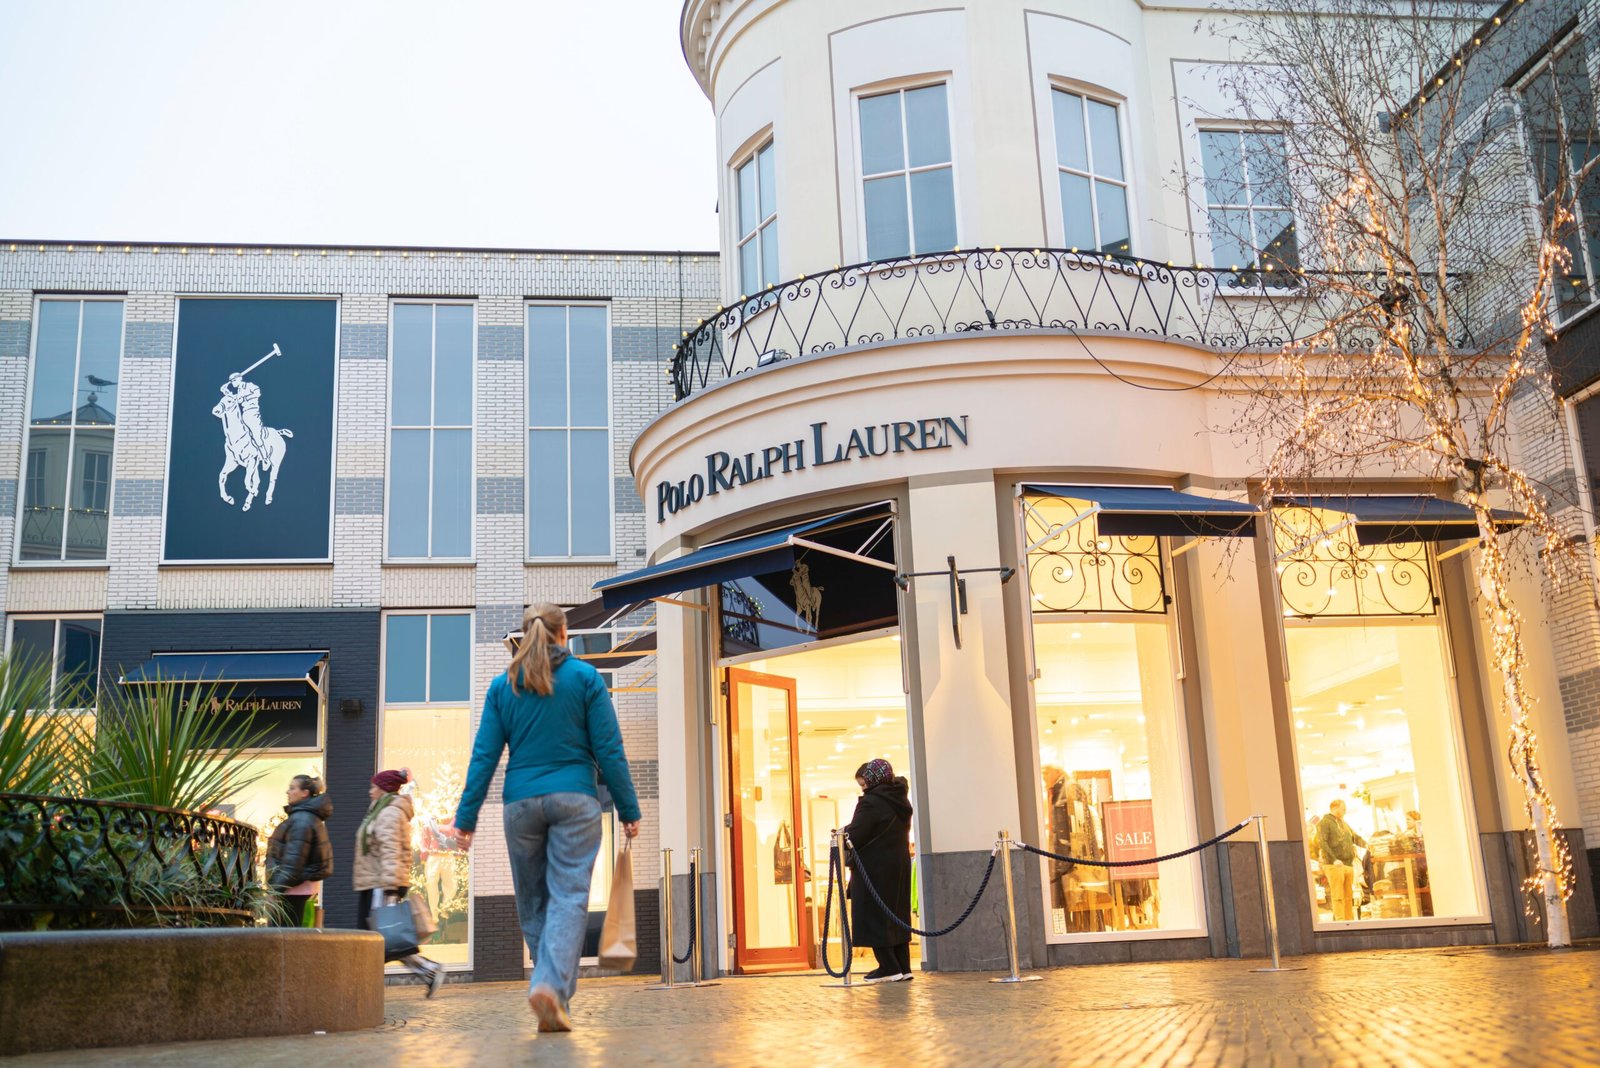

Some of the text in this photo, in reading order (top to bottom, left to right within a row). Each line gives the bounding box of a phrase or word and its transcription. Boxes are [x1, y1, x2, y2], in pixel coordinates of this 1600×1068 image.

[656, 415, 969, 524] POLO RALPH LAUREN
[1115, 832, 1152, 846] SALE
